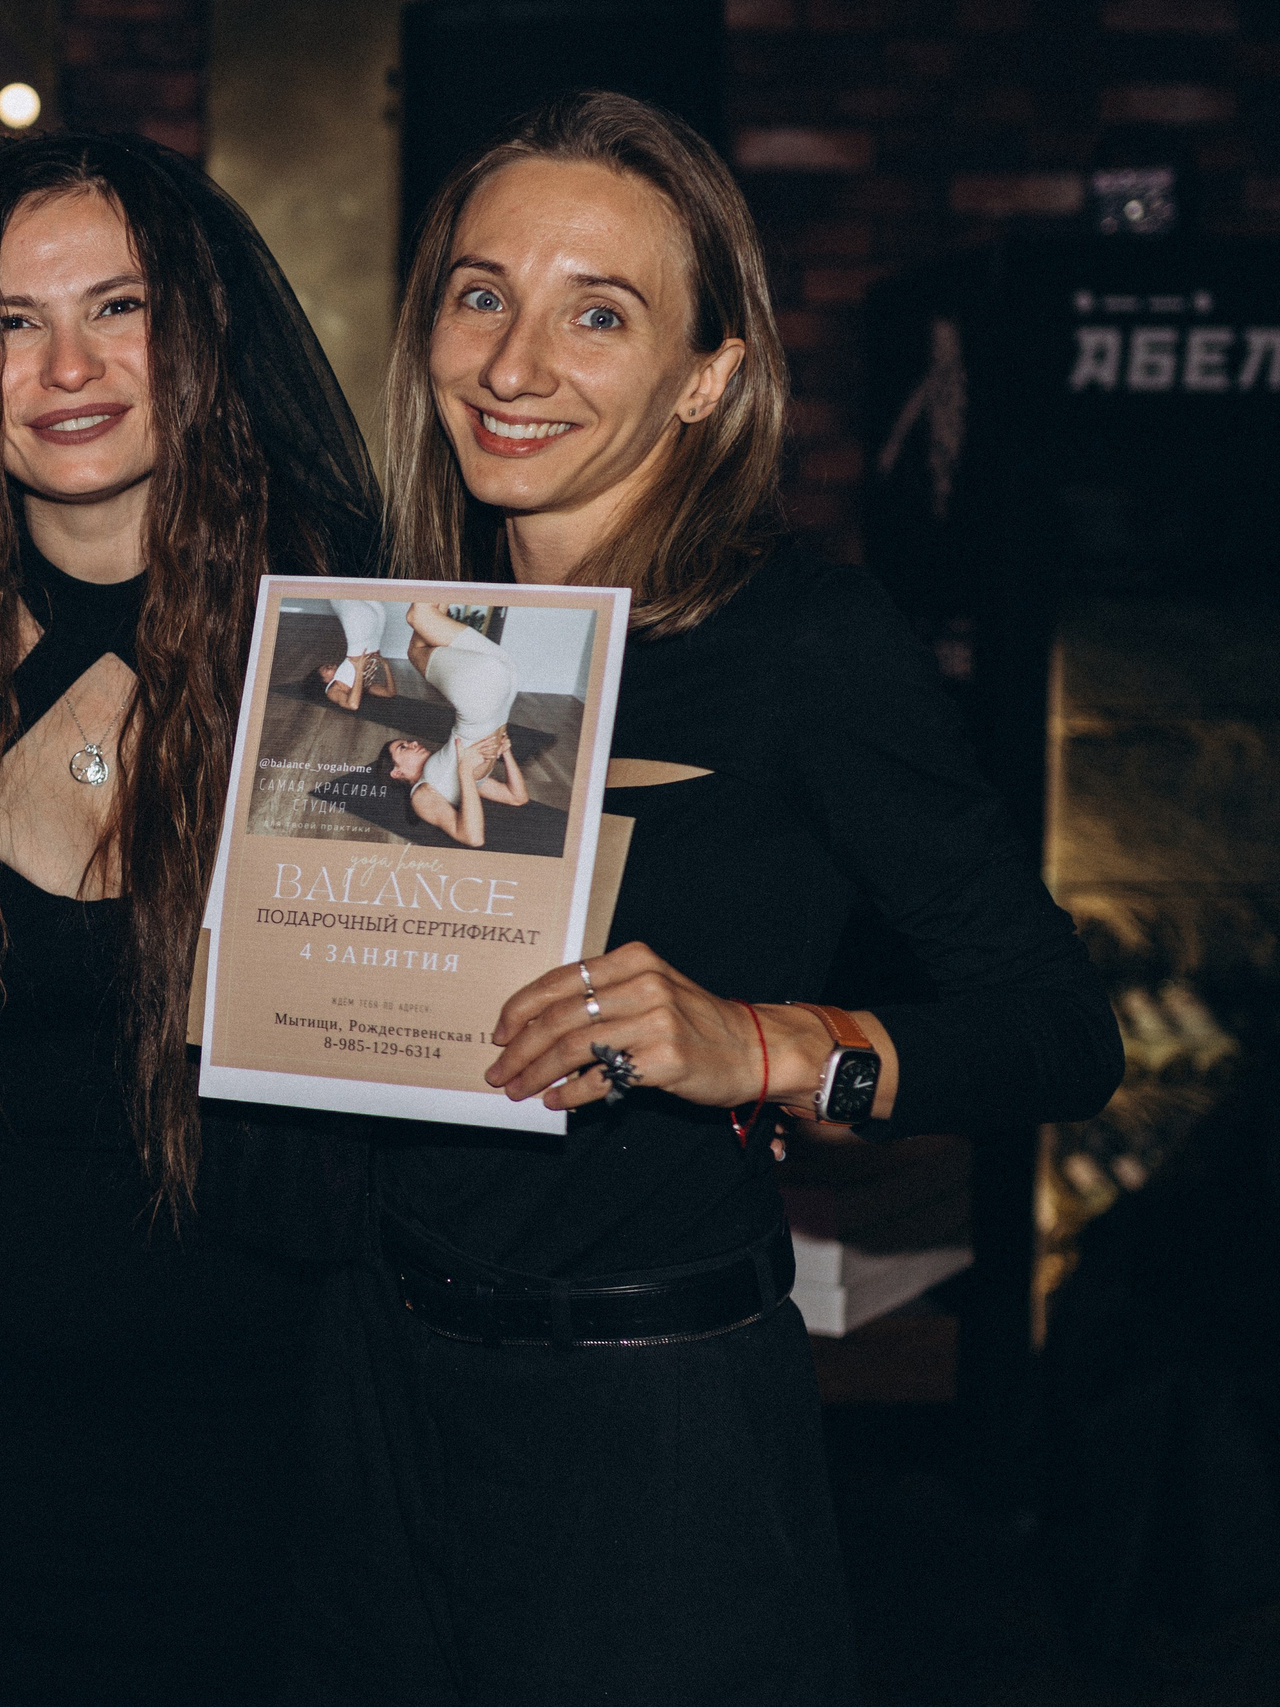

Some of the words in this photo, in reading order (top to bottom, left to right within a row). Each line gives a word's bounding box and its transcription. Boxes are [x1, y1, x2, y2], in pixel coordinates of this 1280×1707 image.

[259, 758, 372, 774] @balance_yogahome
[259, 777, 305, 793] САМАЯ
[314, 782, 388, 798] КРАСИВАЯ
[292, 798, 347, 815] СТУДИЯ
[320, 823, 371, 833] практики
[272, 862, 519, 917] BALANCE
[256, 908, 399, 934] ПОДАРОЧНЫЙ
[402, 919, 541, 946] СЕРТИФИКАТ
[299, 942, 312, 961] 4
[325, 943, 460, 973] ЗАНЯТИЯ
[274, 1012, 342, 1032] Мытищи,
[349, 1019, 472, 1043] Рождественская
[323, 1036, 441, 1059] 8-985-129-6314
